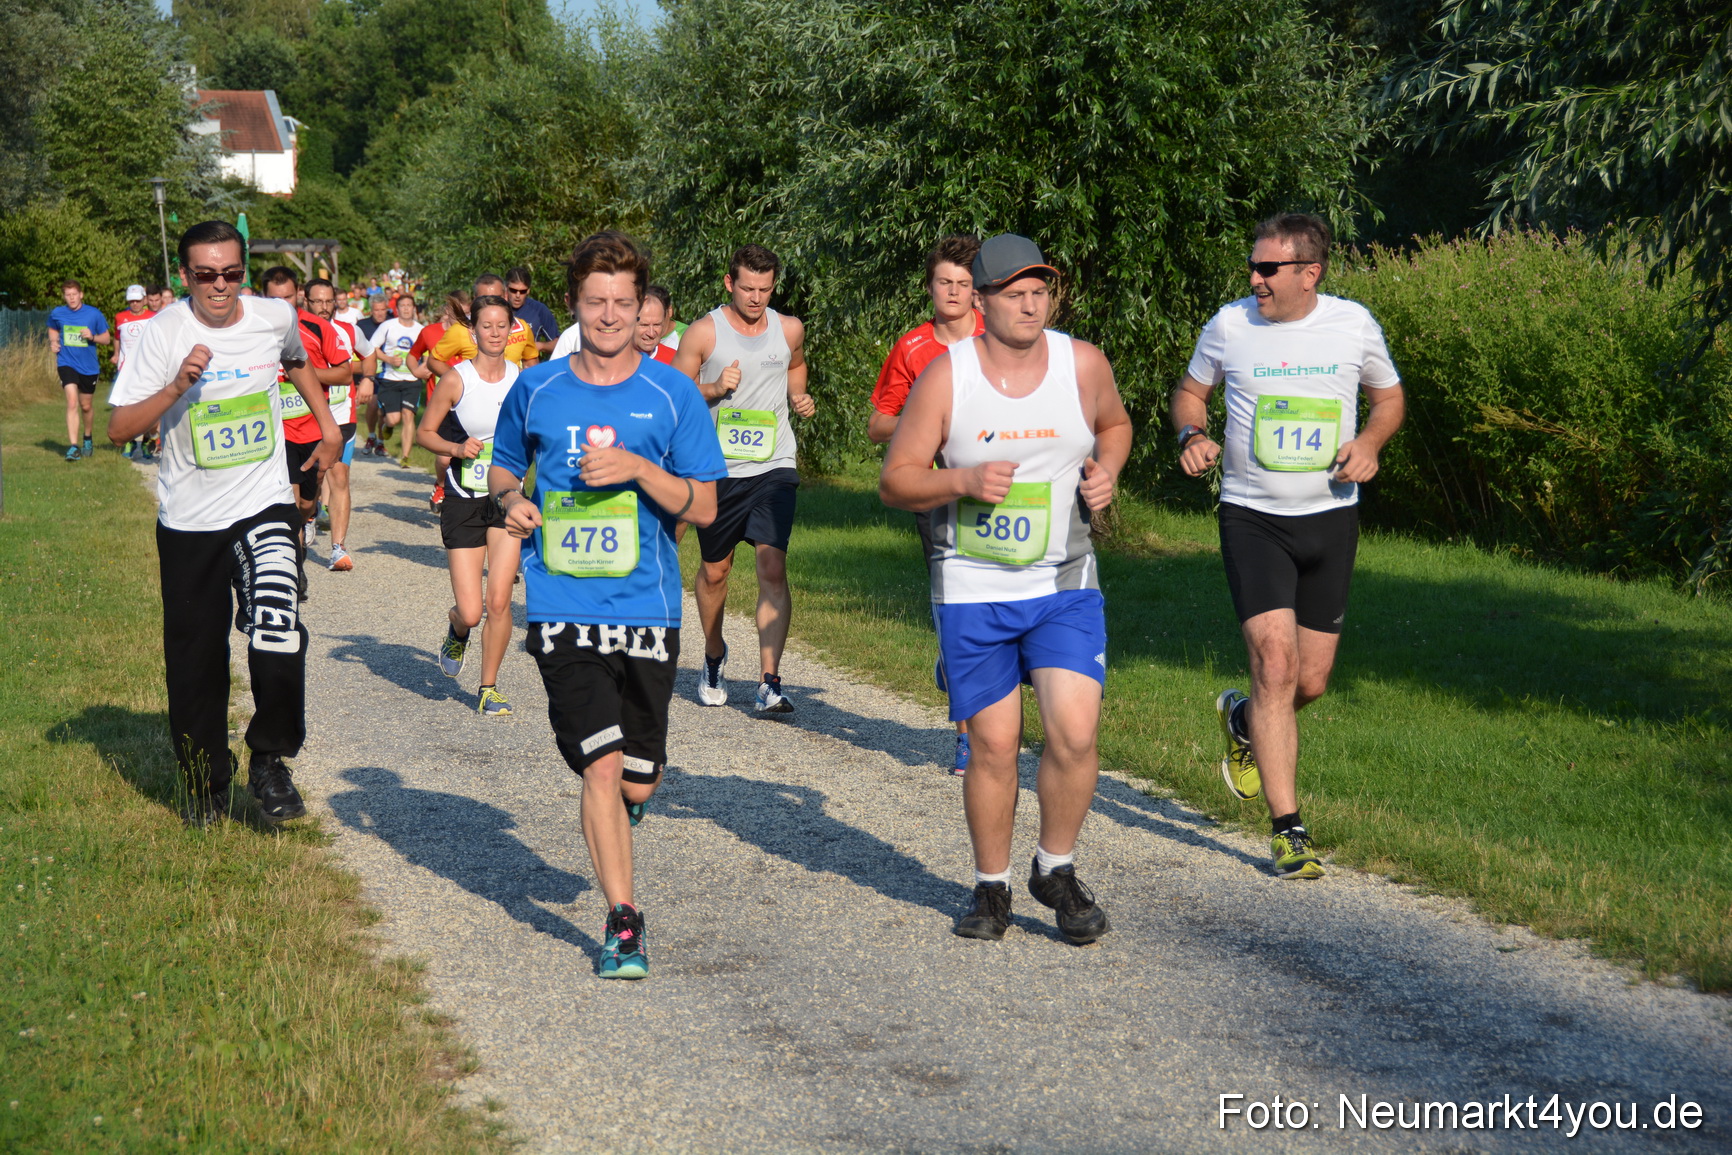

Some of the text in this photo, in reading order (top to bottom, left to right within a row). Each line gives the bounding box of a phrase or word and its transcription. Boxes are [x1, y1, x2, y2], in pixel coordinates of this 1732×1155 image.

[1253, 364, 1339, 377] Gleichauf
[203, 420, 267, 451] 1312
[566, 425, 581, 454] I
[728, 429, 764, 447] 362
[999, 429, 1061, 440] KLEBL
[1273, 426, 1322, 451] 114
[207, 453, 229, 461] Christian
[561, 526, 619, 553] 478
[975, 512, 1031, 542] 580
[247, 522, 300, 654] LIMITED
[541, 622, 669, 662] PYREX
[589, 730, 617, 750] pyrex
[624, 760, 644, 770] rex
